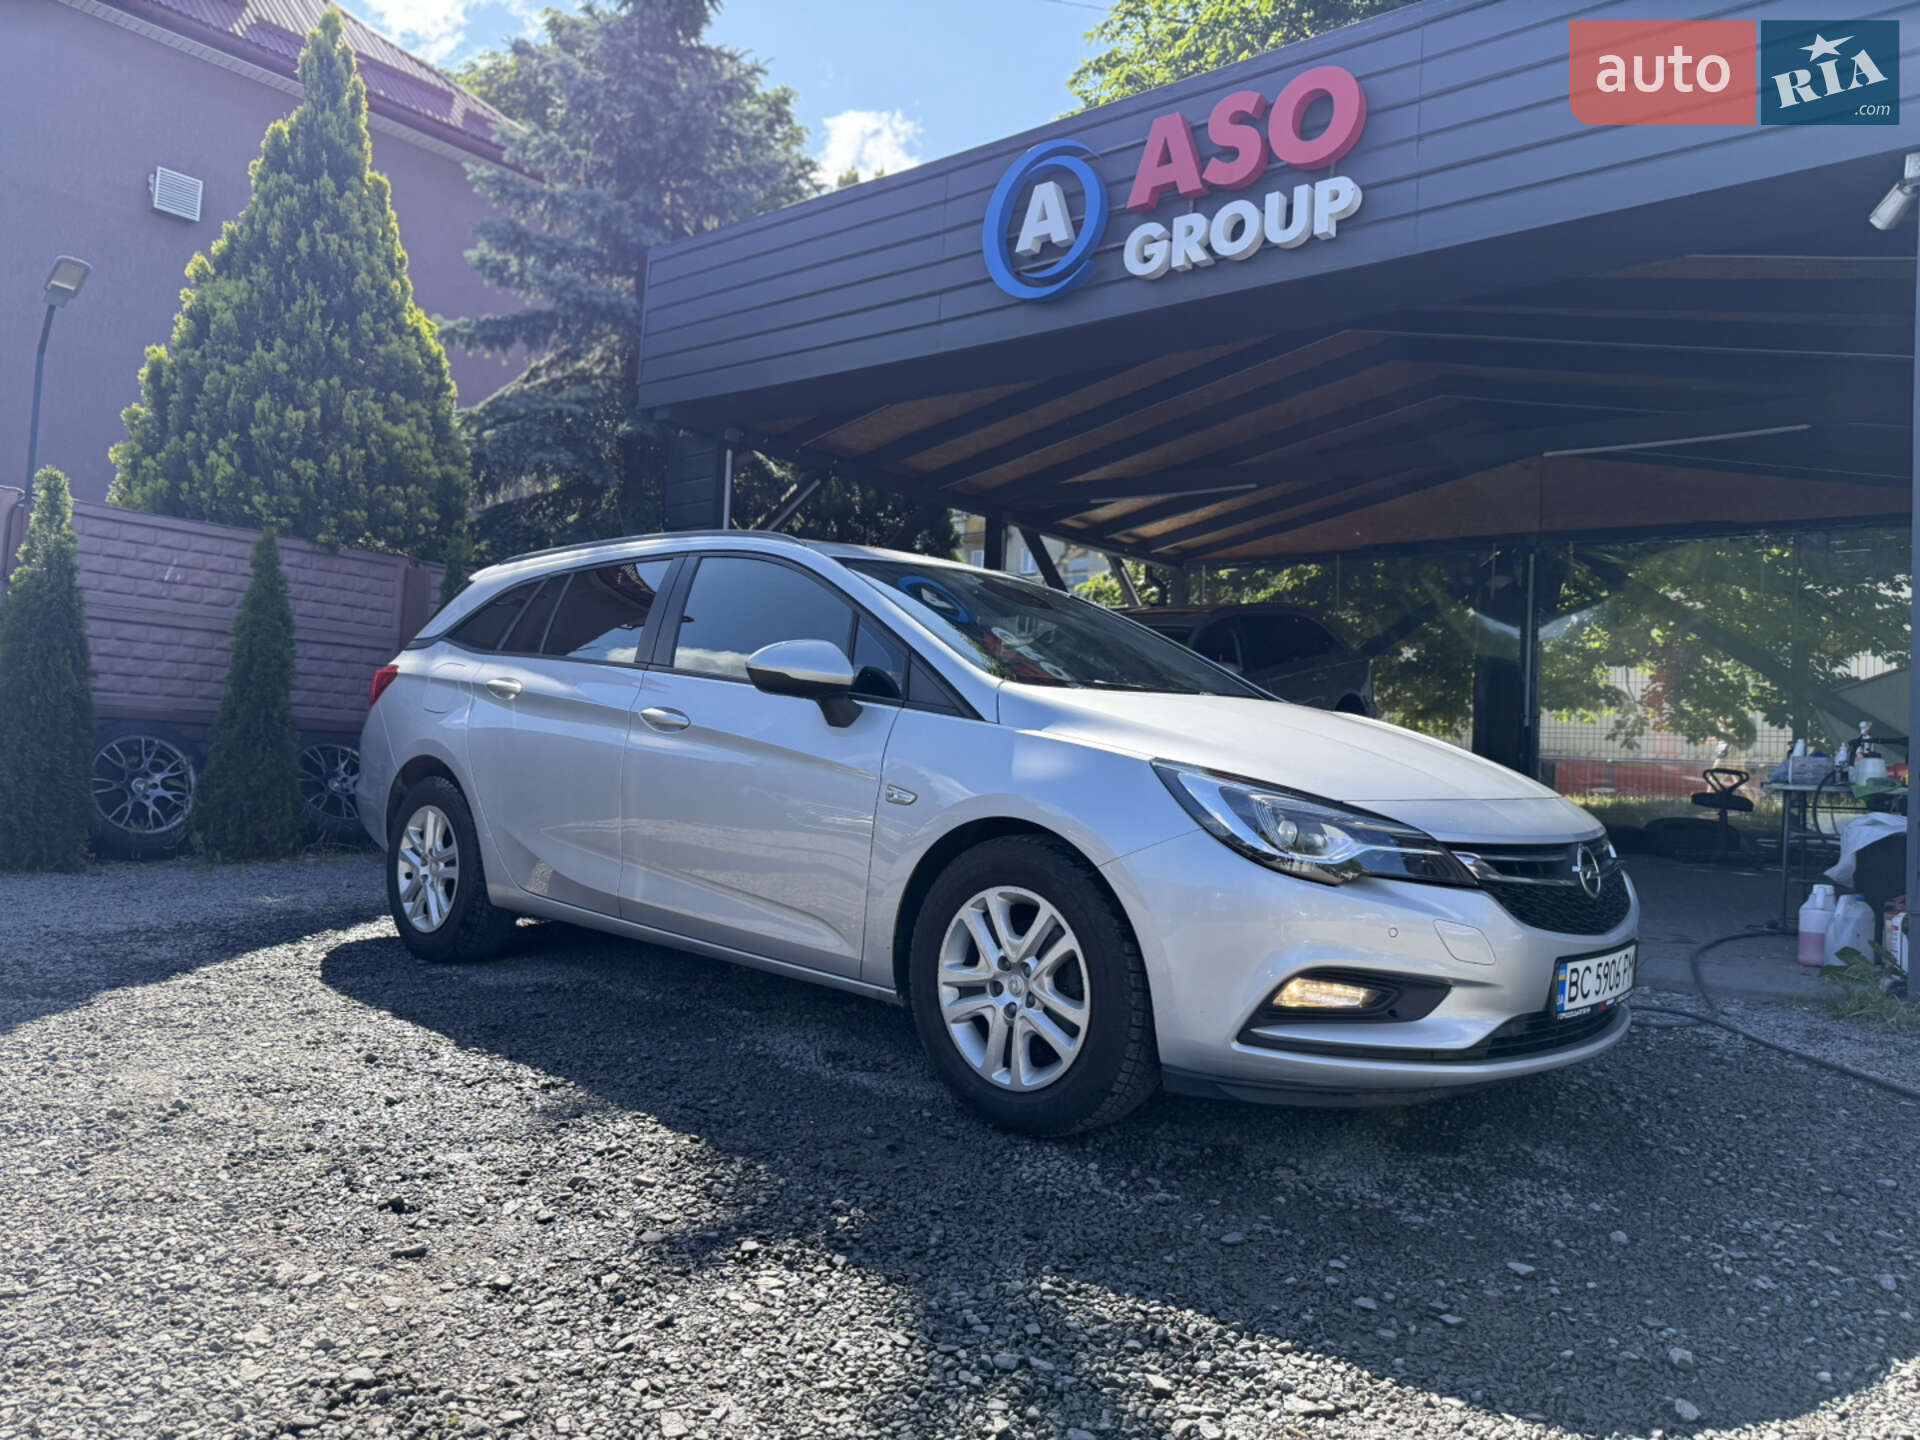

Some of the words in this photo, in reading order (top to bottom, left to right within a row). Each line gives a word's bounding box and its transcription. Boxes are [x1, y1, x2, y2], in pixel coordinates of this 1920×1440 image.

[1127, 66, 1367, 212] ASO
[1015, 181, 1076, 256] A
[1123, 176, 1362, 280] GROUP
[1567, 966, 1592, 1003] BC
[1594, 956, 1622, 995] 5906
